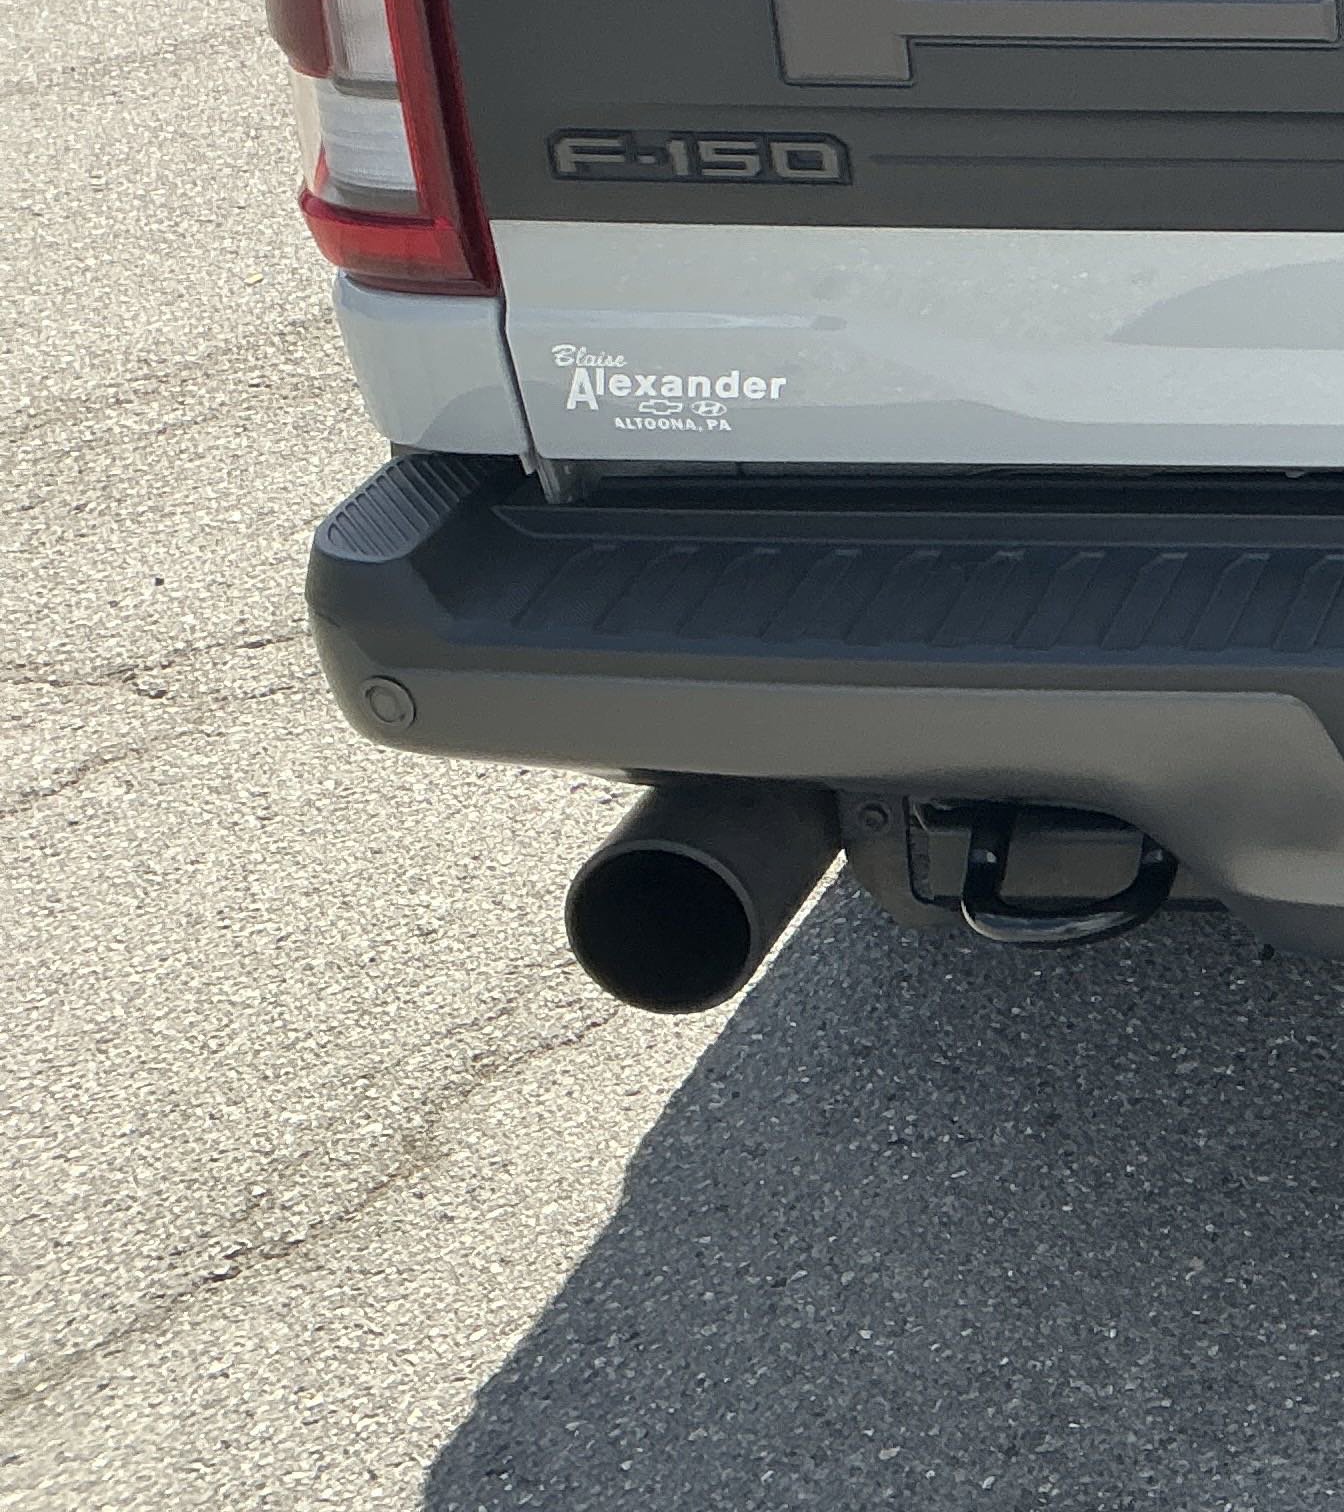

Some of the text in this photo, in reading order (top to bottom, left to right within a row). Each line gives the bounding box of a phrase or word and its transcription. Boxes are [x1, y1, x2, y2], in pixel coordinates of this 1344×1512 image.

[548, 131, 851, 184] F-150
[552, 344, 627, 368] Blaise
[566, 367, 787, 411] Alexander
[614, 416, 732, 433] ALTOONA, PA
